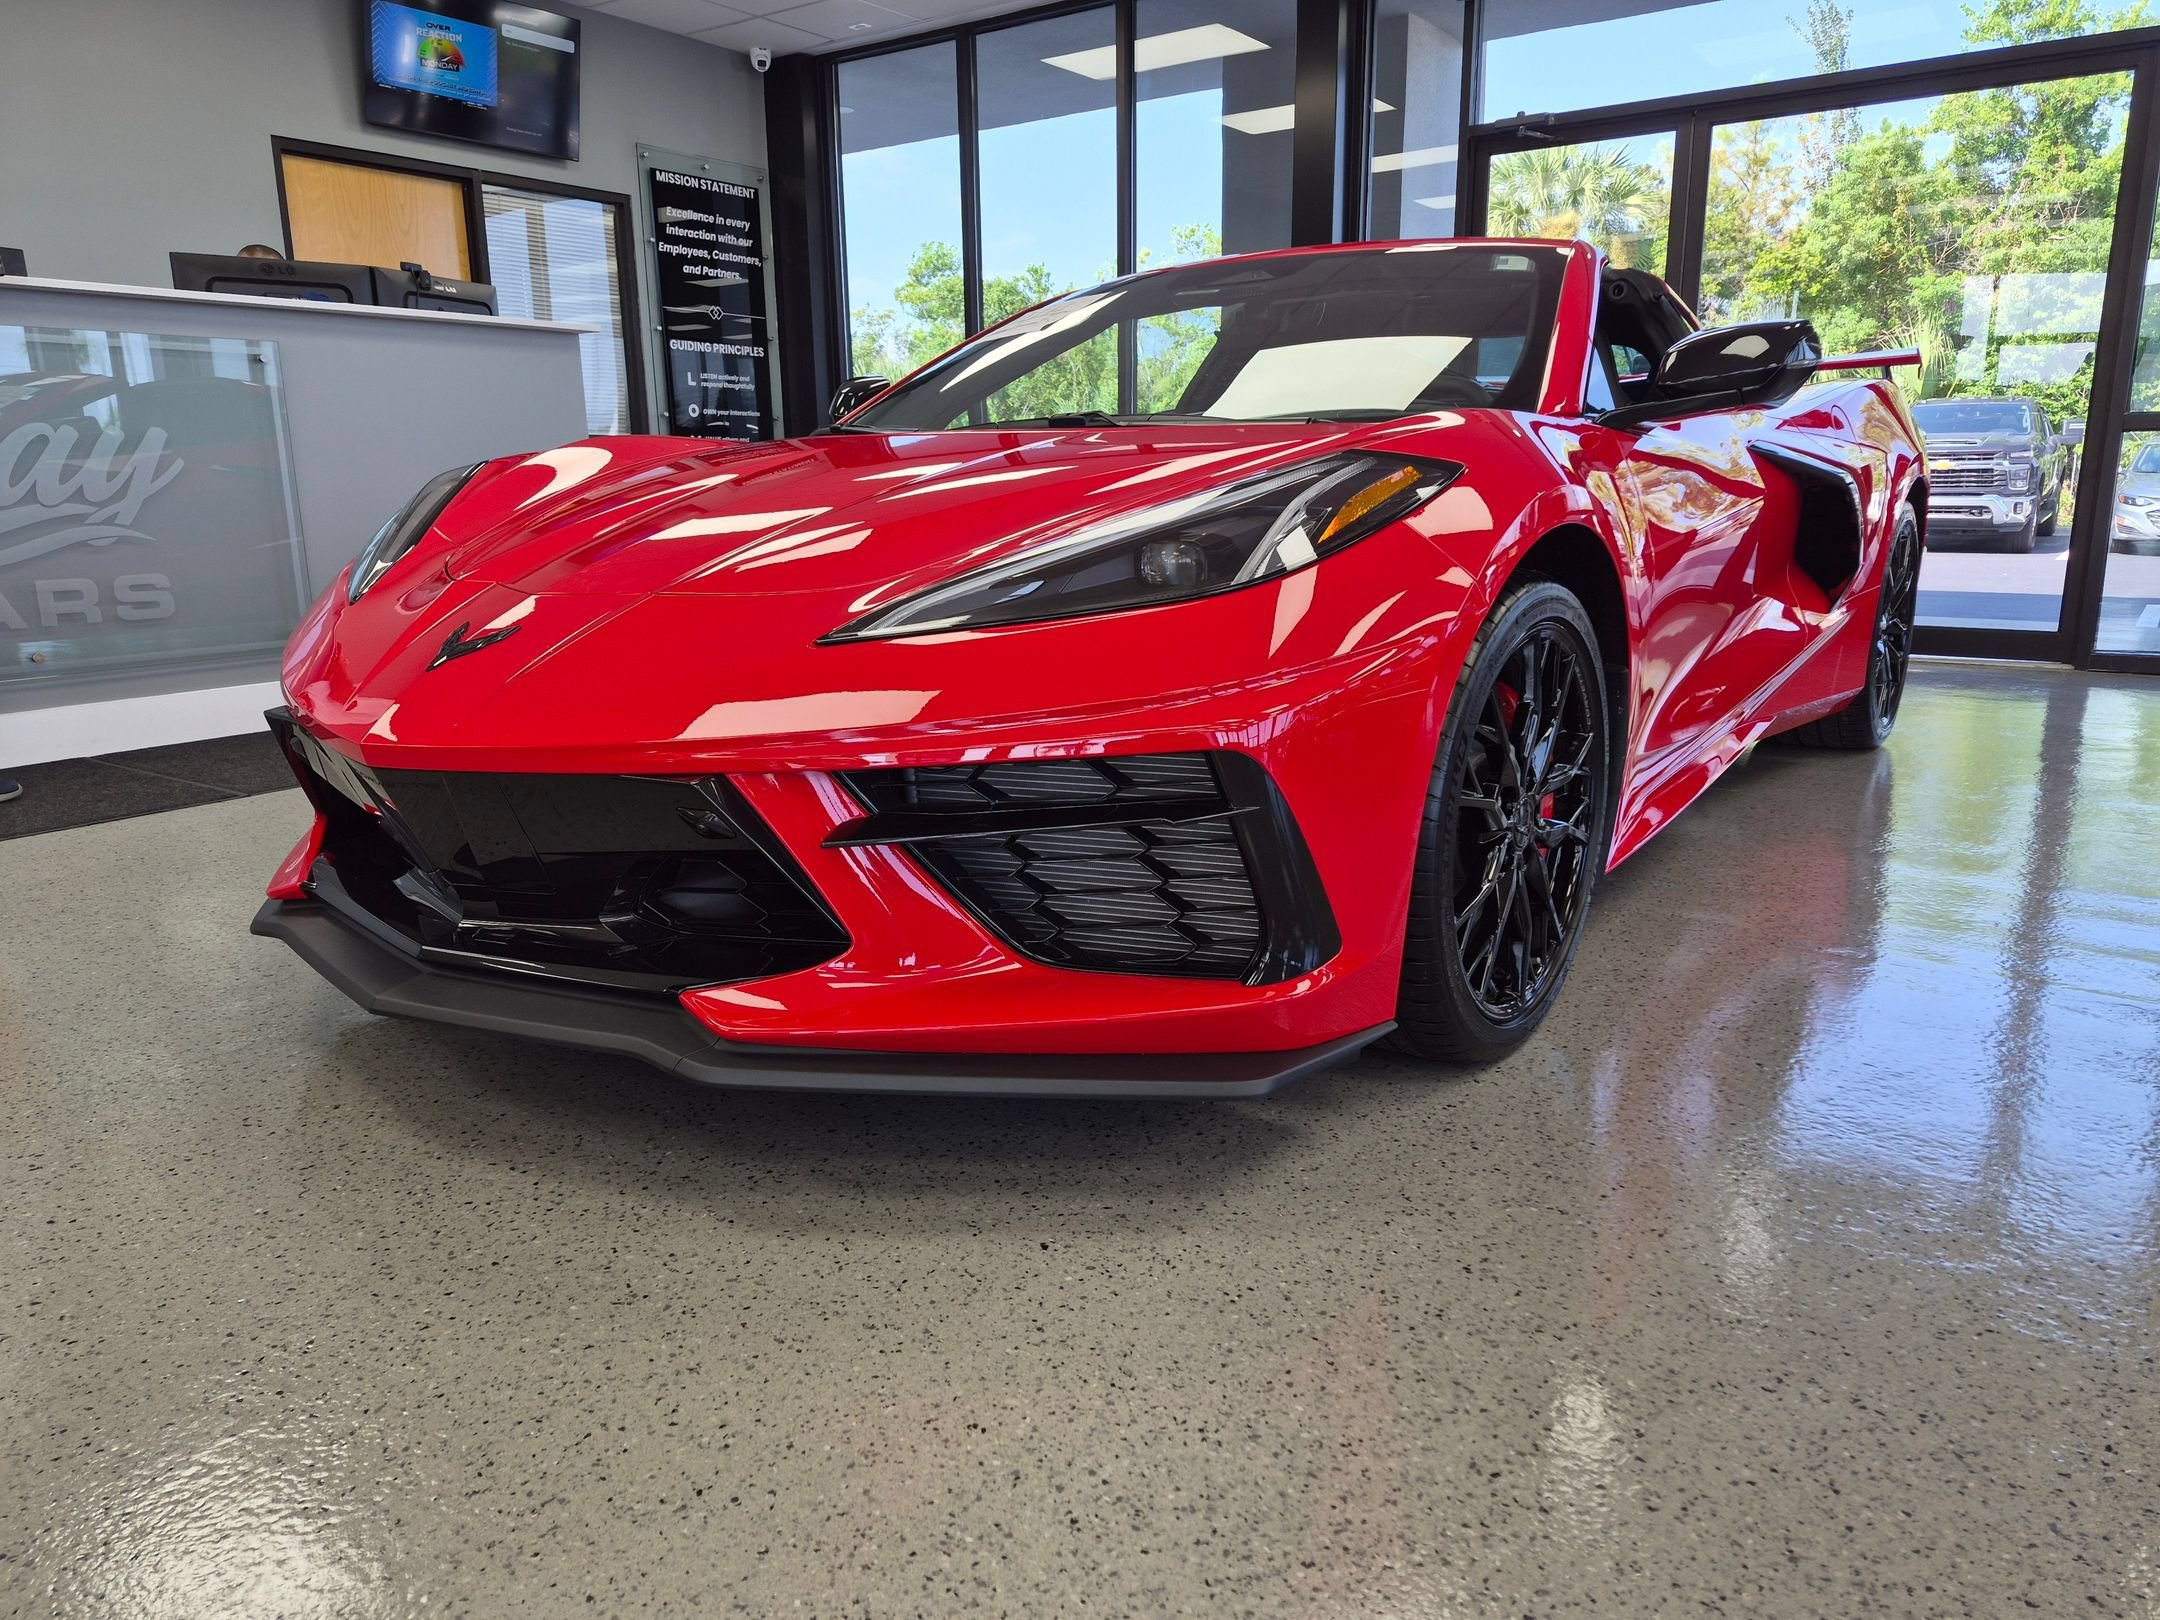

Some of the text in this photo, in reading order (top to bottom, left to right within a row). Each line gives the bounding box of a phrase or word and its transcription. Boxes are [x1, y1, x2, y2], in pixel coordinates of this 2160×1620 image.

[416, 27, 463, 42] REACTION
[426, 22, 451, 32] OVER
[421, 58, 458, 71] MONDAY
[655, 170, 755, 199] MISSION STATEMENT
[666, 206, 751, 232] Excellence in every
[666, 224, 753, 247] interaction with our
[658, 241, 762, 267] Employees, Customers,
[682, 264, 742, 280] and Partners.
[670, 339, 765, 357] GUIDING PRINCIPLES
[687, 371, 697, 386] L
[700, 381, 724, 389] respond
[718, 374, 739, 383] actively
[688, 403, 700, 418] O
